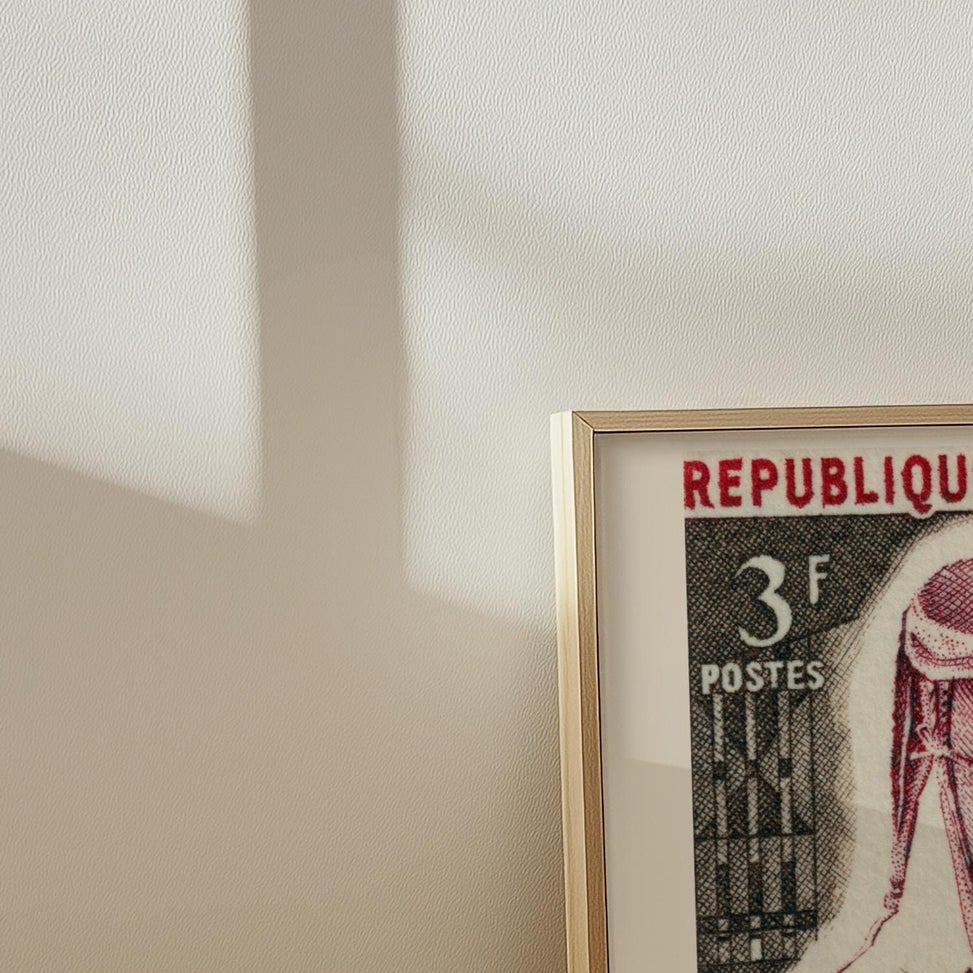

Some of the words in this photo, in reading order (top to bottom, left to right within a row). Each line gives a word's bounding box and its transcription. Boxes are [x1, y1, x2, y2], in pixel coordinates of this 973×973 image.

[734, 555, 792, 647] 3
[809, 554, 830, 604] F
[701, 660, 825, 694] POSTES
